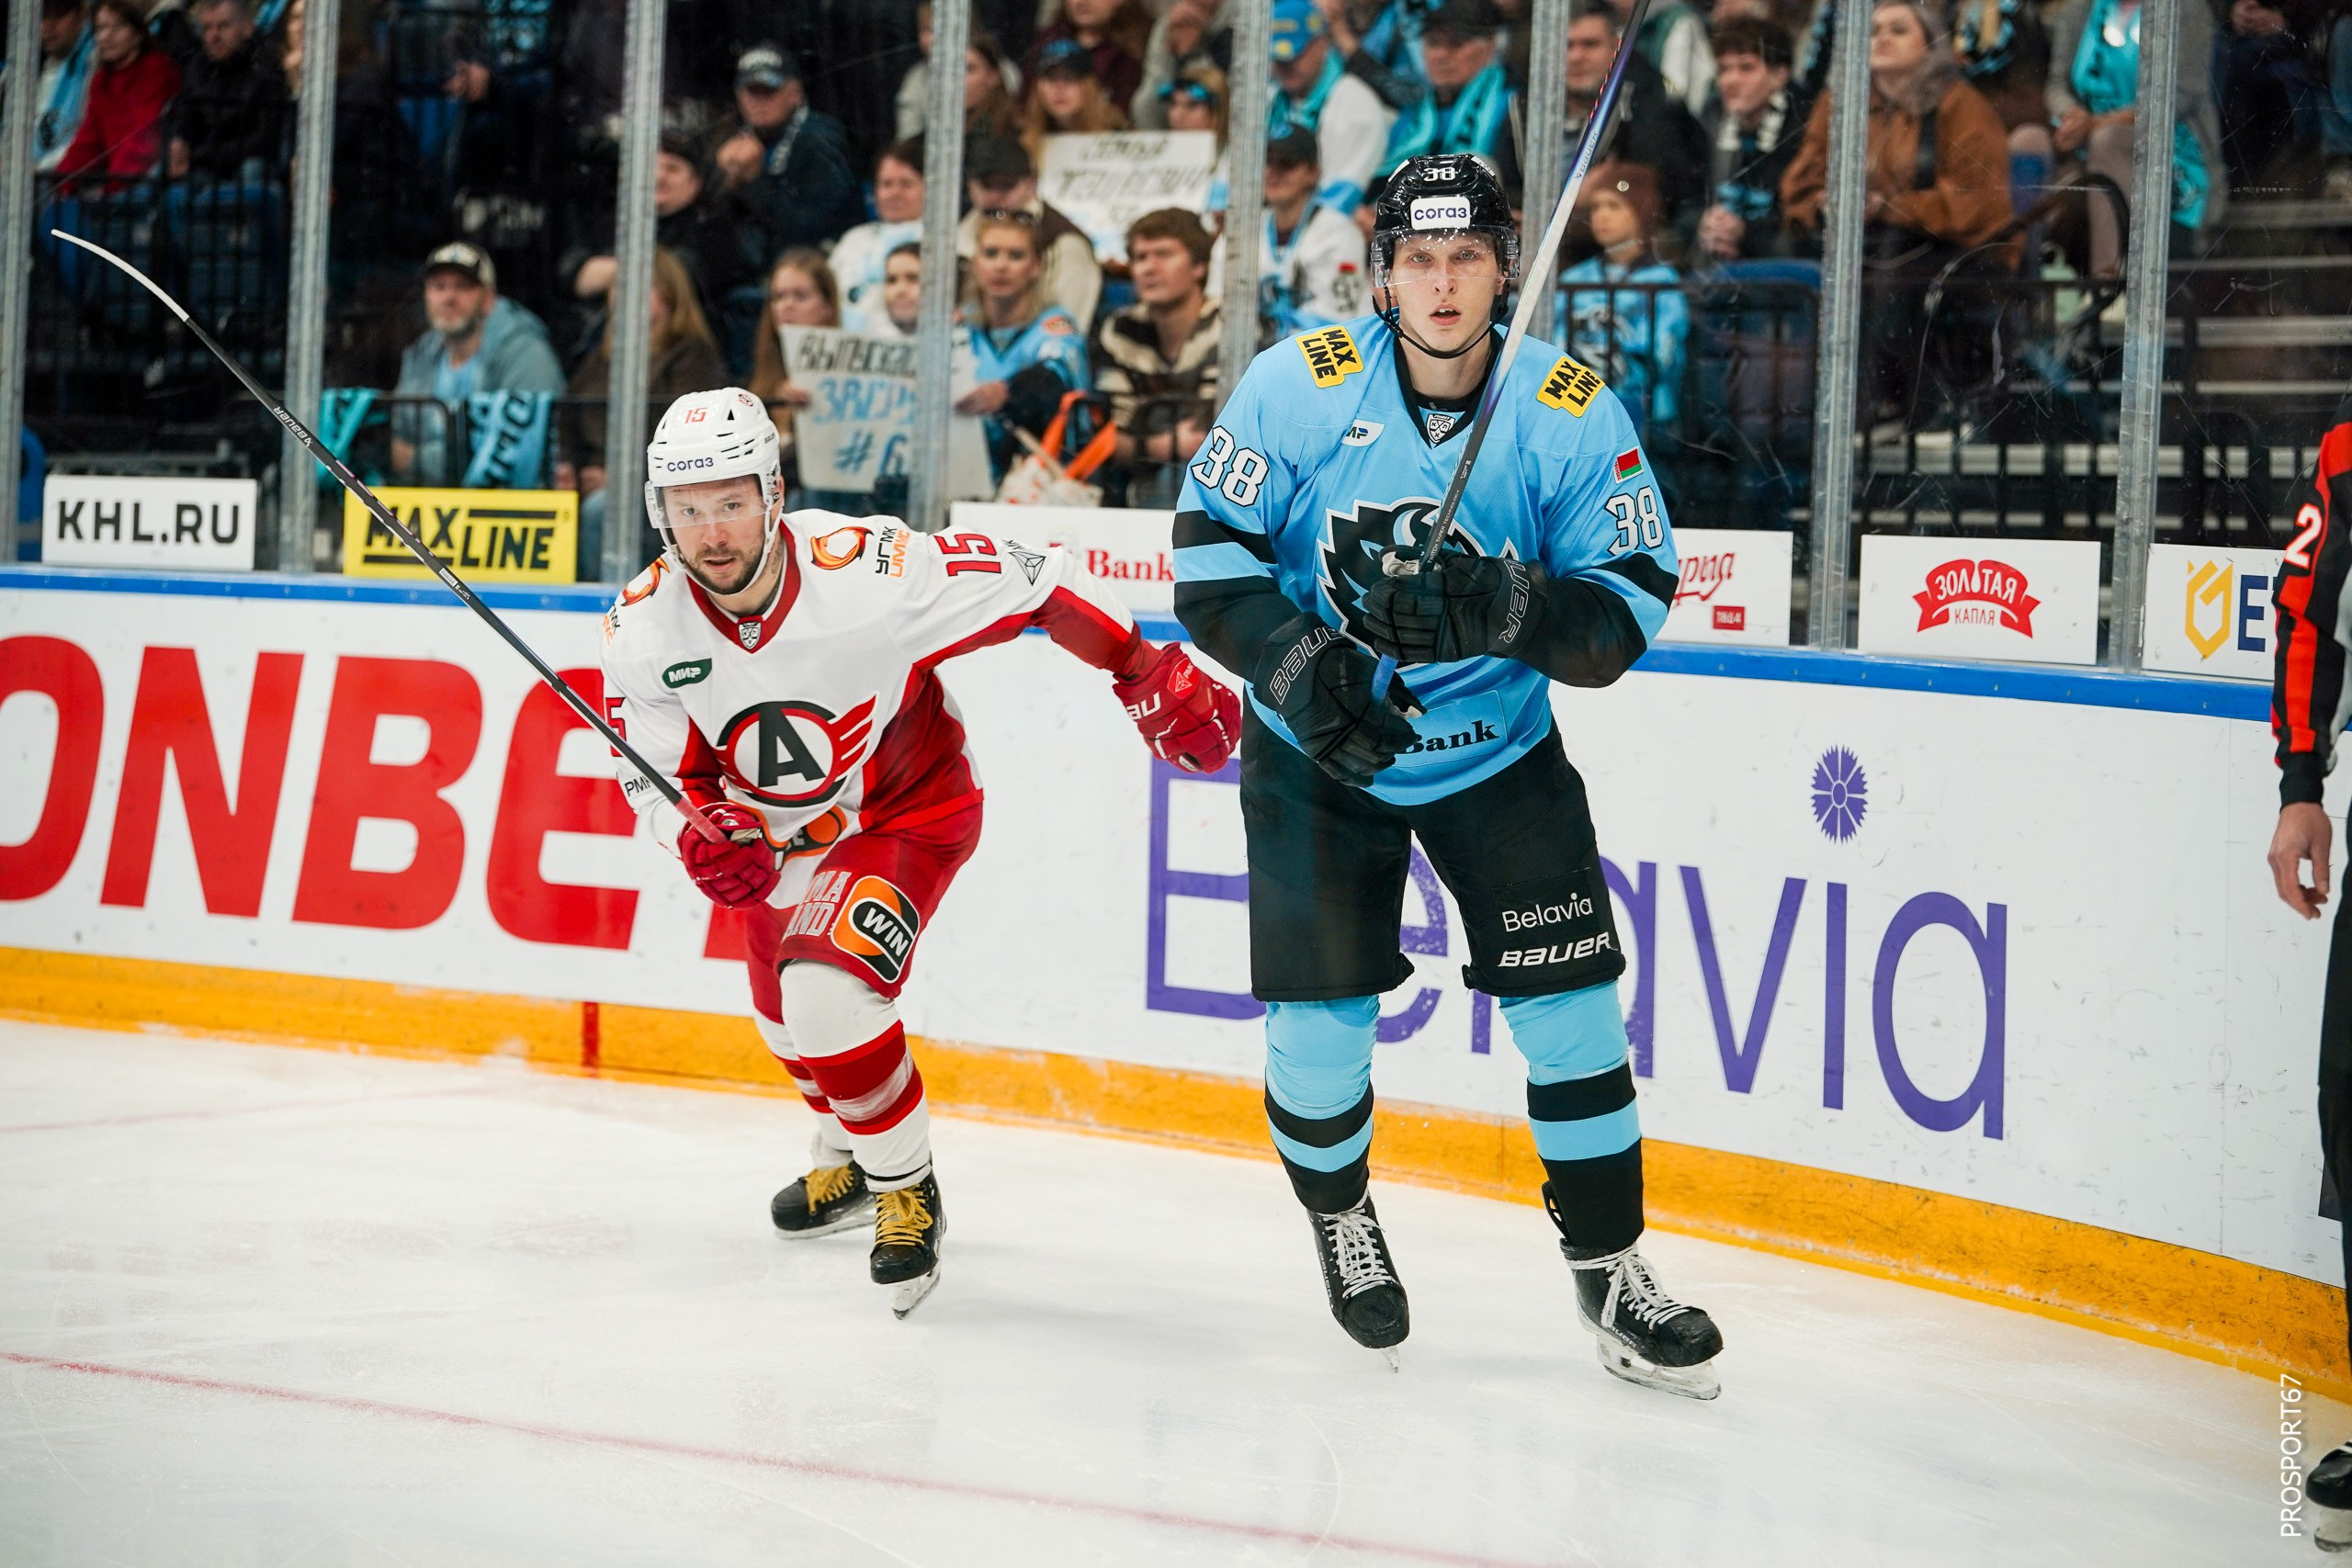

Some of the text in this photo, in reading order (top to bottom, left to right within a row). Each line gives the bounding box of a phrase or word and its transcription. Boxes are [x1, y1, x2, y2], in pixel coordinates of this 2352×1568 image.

[1423, 166, 1456, 182] 38
[1415, 207, 1467, 220] согаз
[1303, 337, 1337, 378] LINE
[1323, 329, 1357, 367] MAX
[1544, 360, 1581, 400] MAX
[1567, 370, 1600, 407] LINE
[684, 407, 708, 423] 15
[667, 457, 714, 472] согаз
[1191, 425, 1270, 507] 38
[58, 501, 239, 544] KHL.RU
[1436, 525, 1446, 543] TAPER
[1443, 489, 1461, 525] TECHNOLOGY
[1604, 485, 1665, 557] 38
[876, 525, 898, 575] УГМК
[933, 534, 1001, 577] 15
[1087, 549, 1175, 582] Bank
[1954, 608, 1996, 626] КАПЛЯ
[668, 666, 702, 683] МИР
[0, 635, 746, 961] ONBE
[862, 907, 910, 957] WIN
[1501, 892, 1594, 932] Belavia
[1610, 1325, 1637, 1348] AUER
